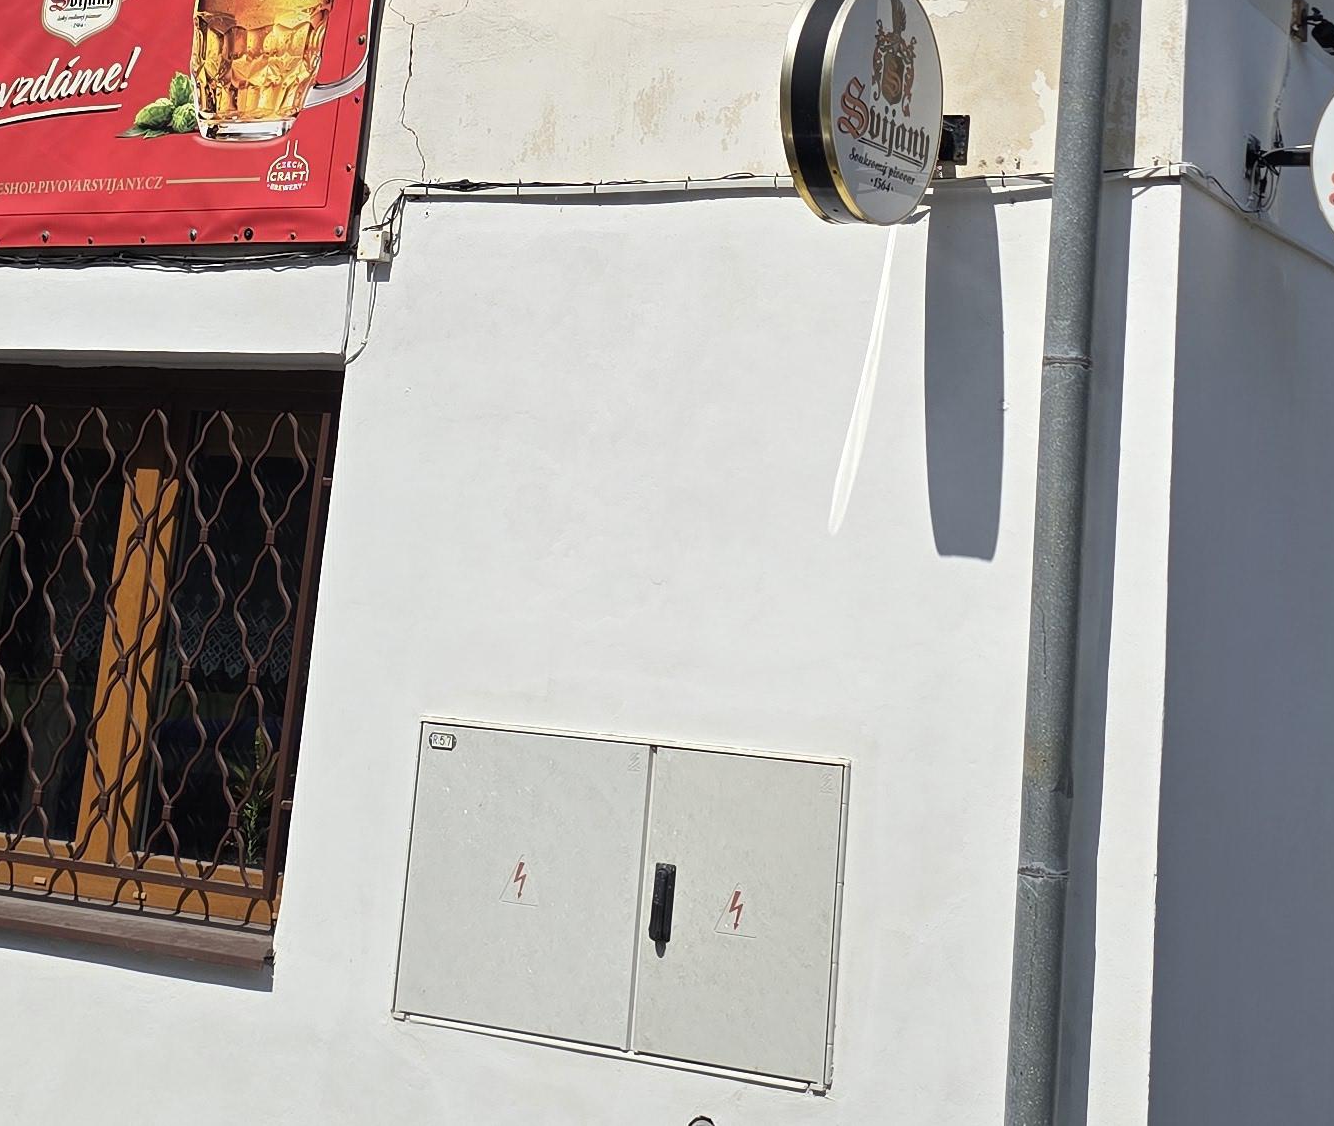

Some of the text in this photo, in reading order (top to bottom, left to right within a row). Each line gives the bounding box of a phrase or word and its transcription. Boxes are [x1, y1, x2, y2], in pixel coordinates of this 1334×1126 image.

[837, 76, 930, 171] Svijany
[275, 161, 303, 169] CZECH
[849, 147, 887, 176] Soukromý
[269, 170, 307, 181] CRAFT
